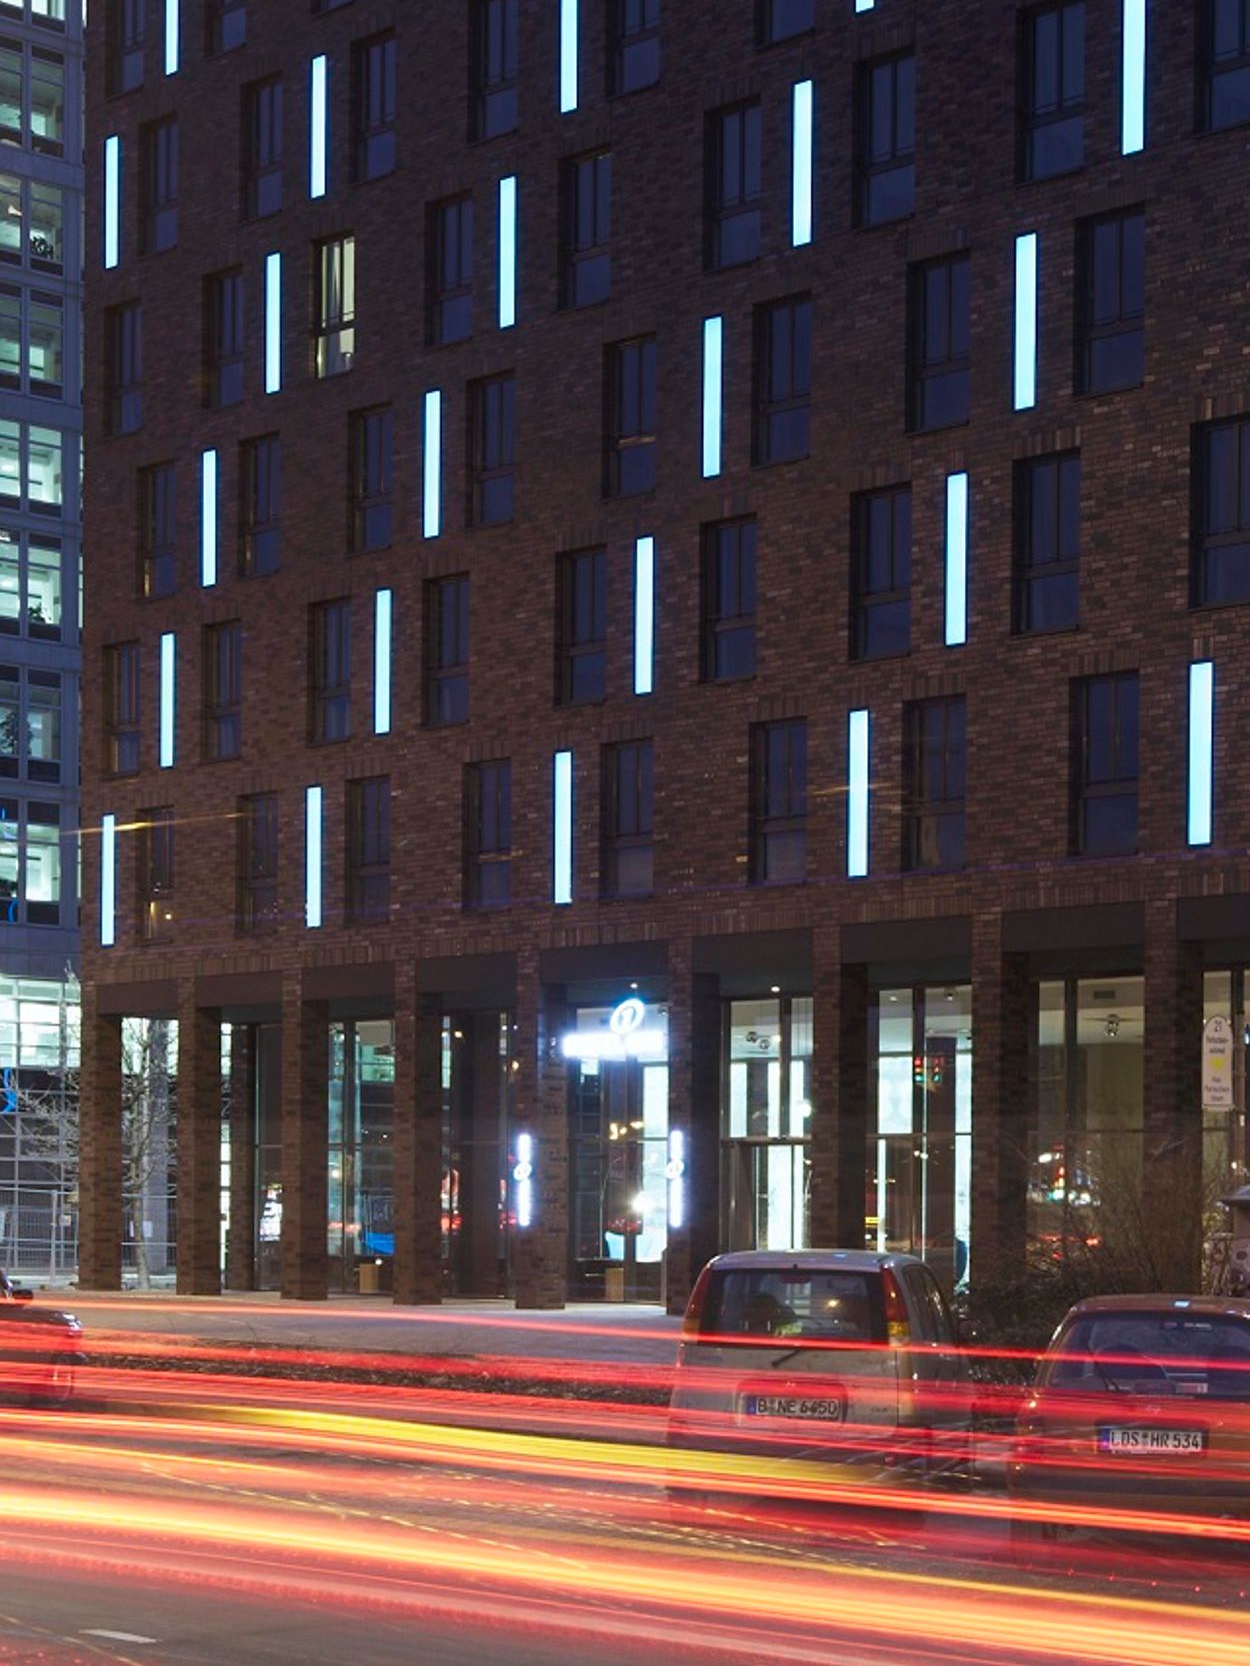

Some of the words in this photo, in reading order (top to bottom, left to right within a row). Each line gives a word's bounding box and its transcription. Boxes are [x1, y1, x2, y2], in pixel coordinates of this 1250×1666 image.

[757, 1398, 767, 1414] B
[1150, 1432, 1168, 1448] HR
[1173, 1432, 1199, 1449] 534
